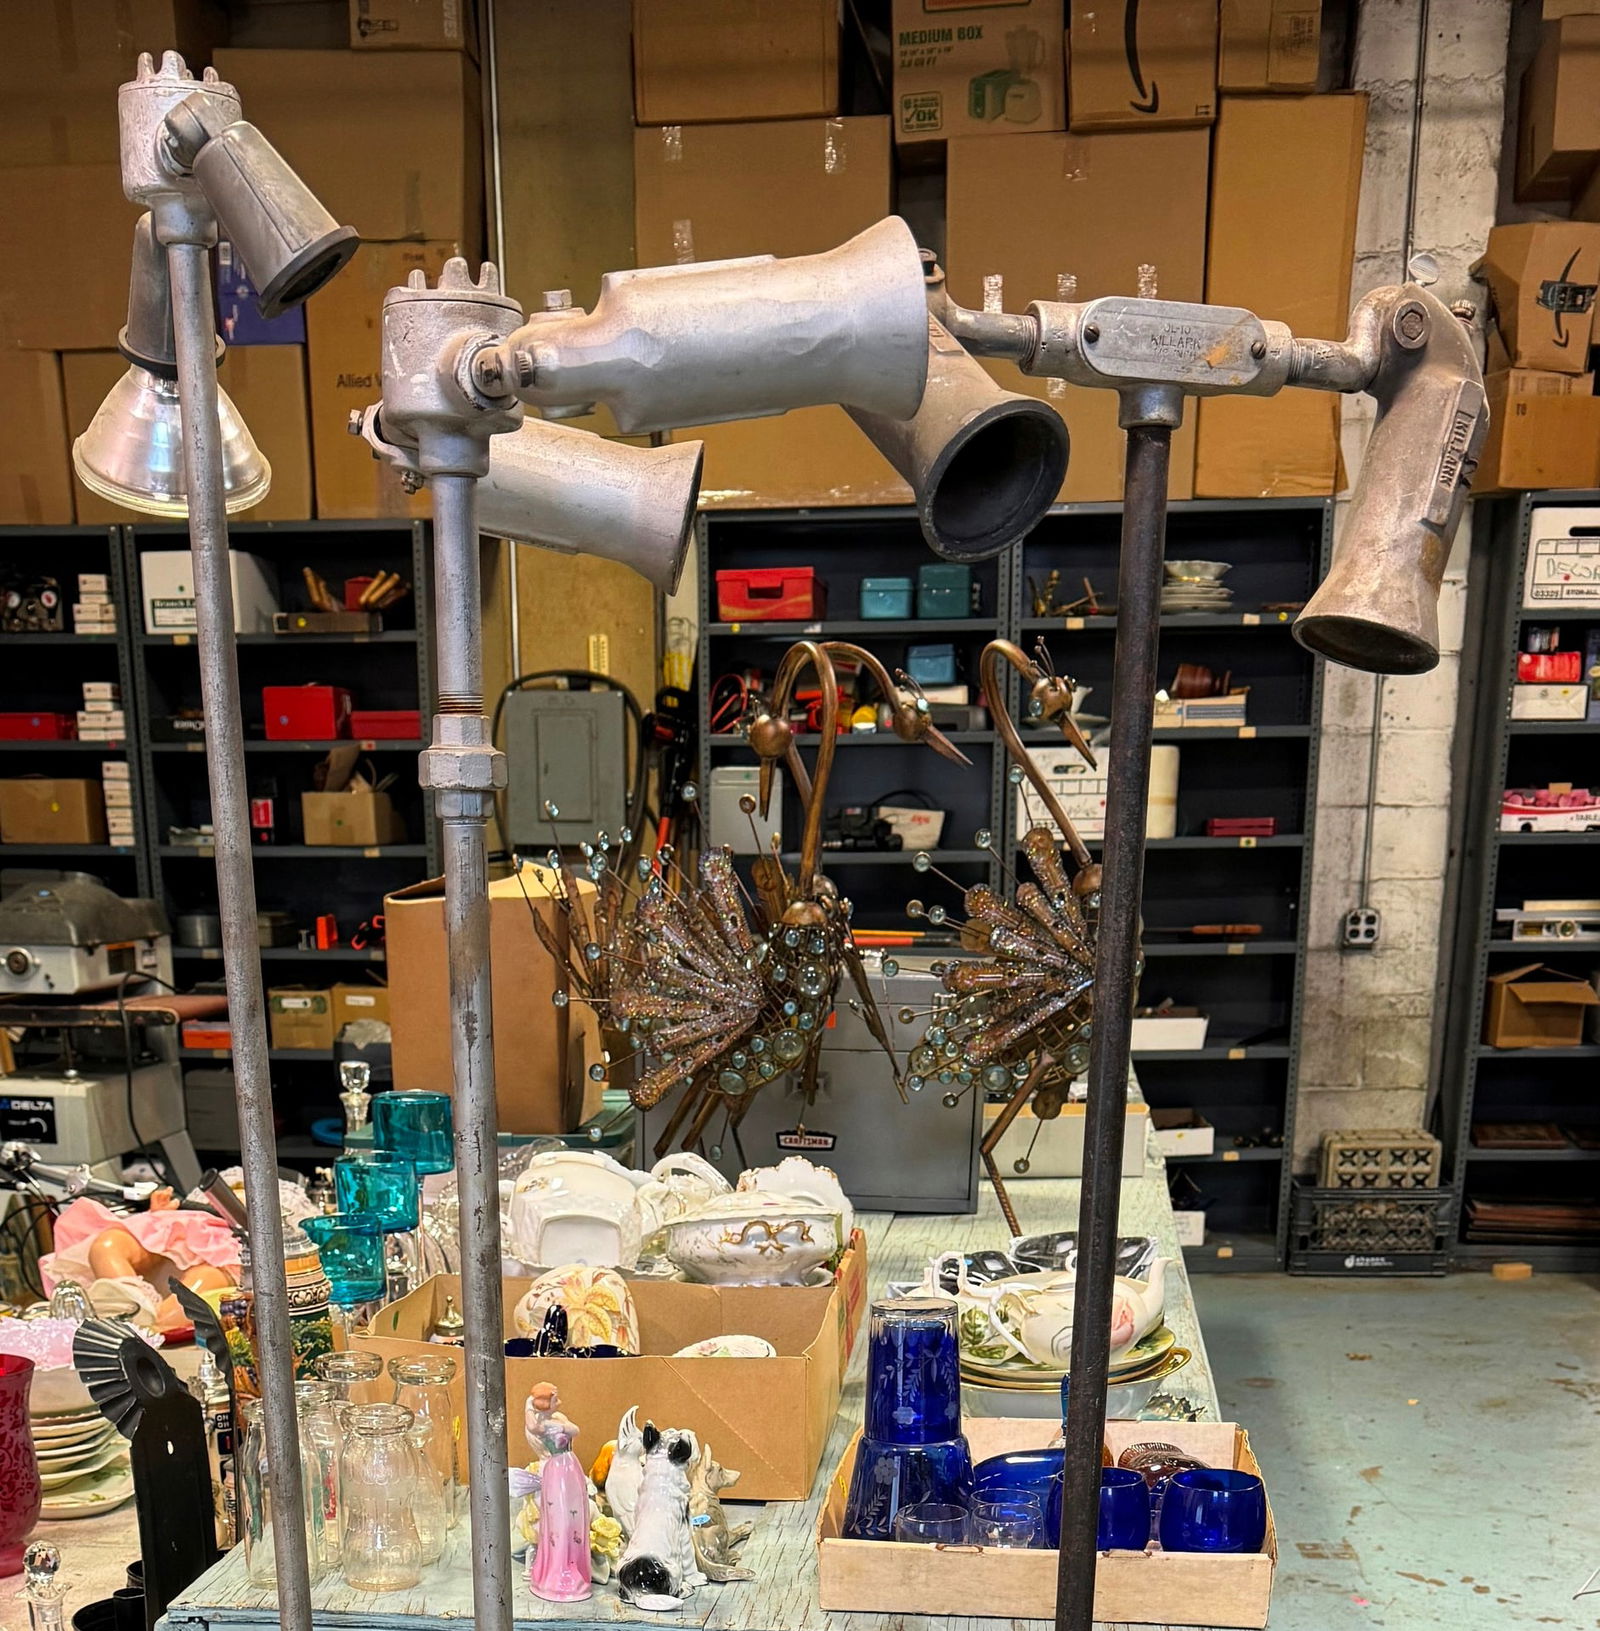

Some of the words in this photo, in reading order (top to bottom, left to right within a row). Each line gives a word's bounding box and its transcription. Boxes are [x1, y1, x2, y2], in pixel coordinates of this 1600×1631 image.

[899, 28, 953, 46] MEDIUM
[957, 24, 984, 40] BOX
[916, 108, 938, 122] OK
[1150, 334, 1201, 350] KILLARK
[336, 374, 372, 388] Allied
[1440, 420, 1468, 488] KILLARK
[11, 1100, 53, 1111] DELTA
